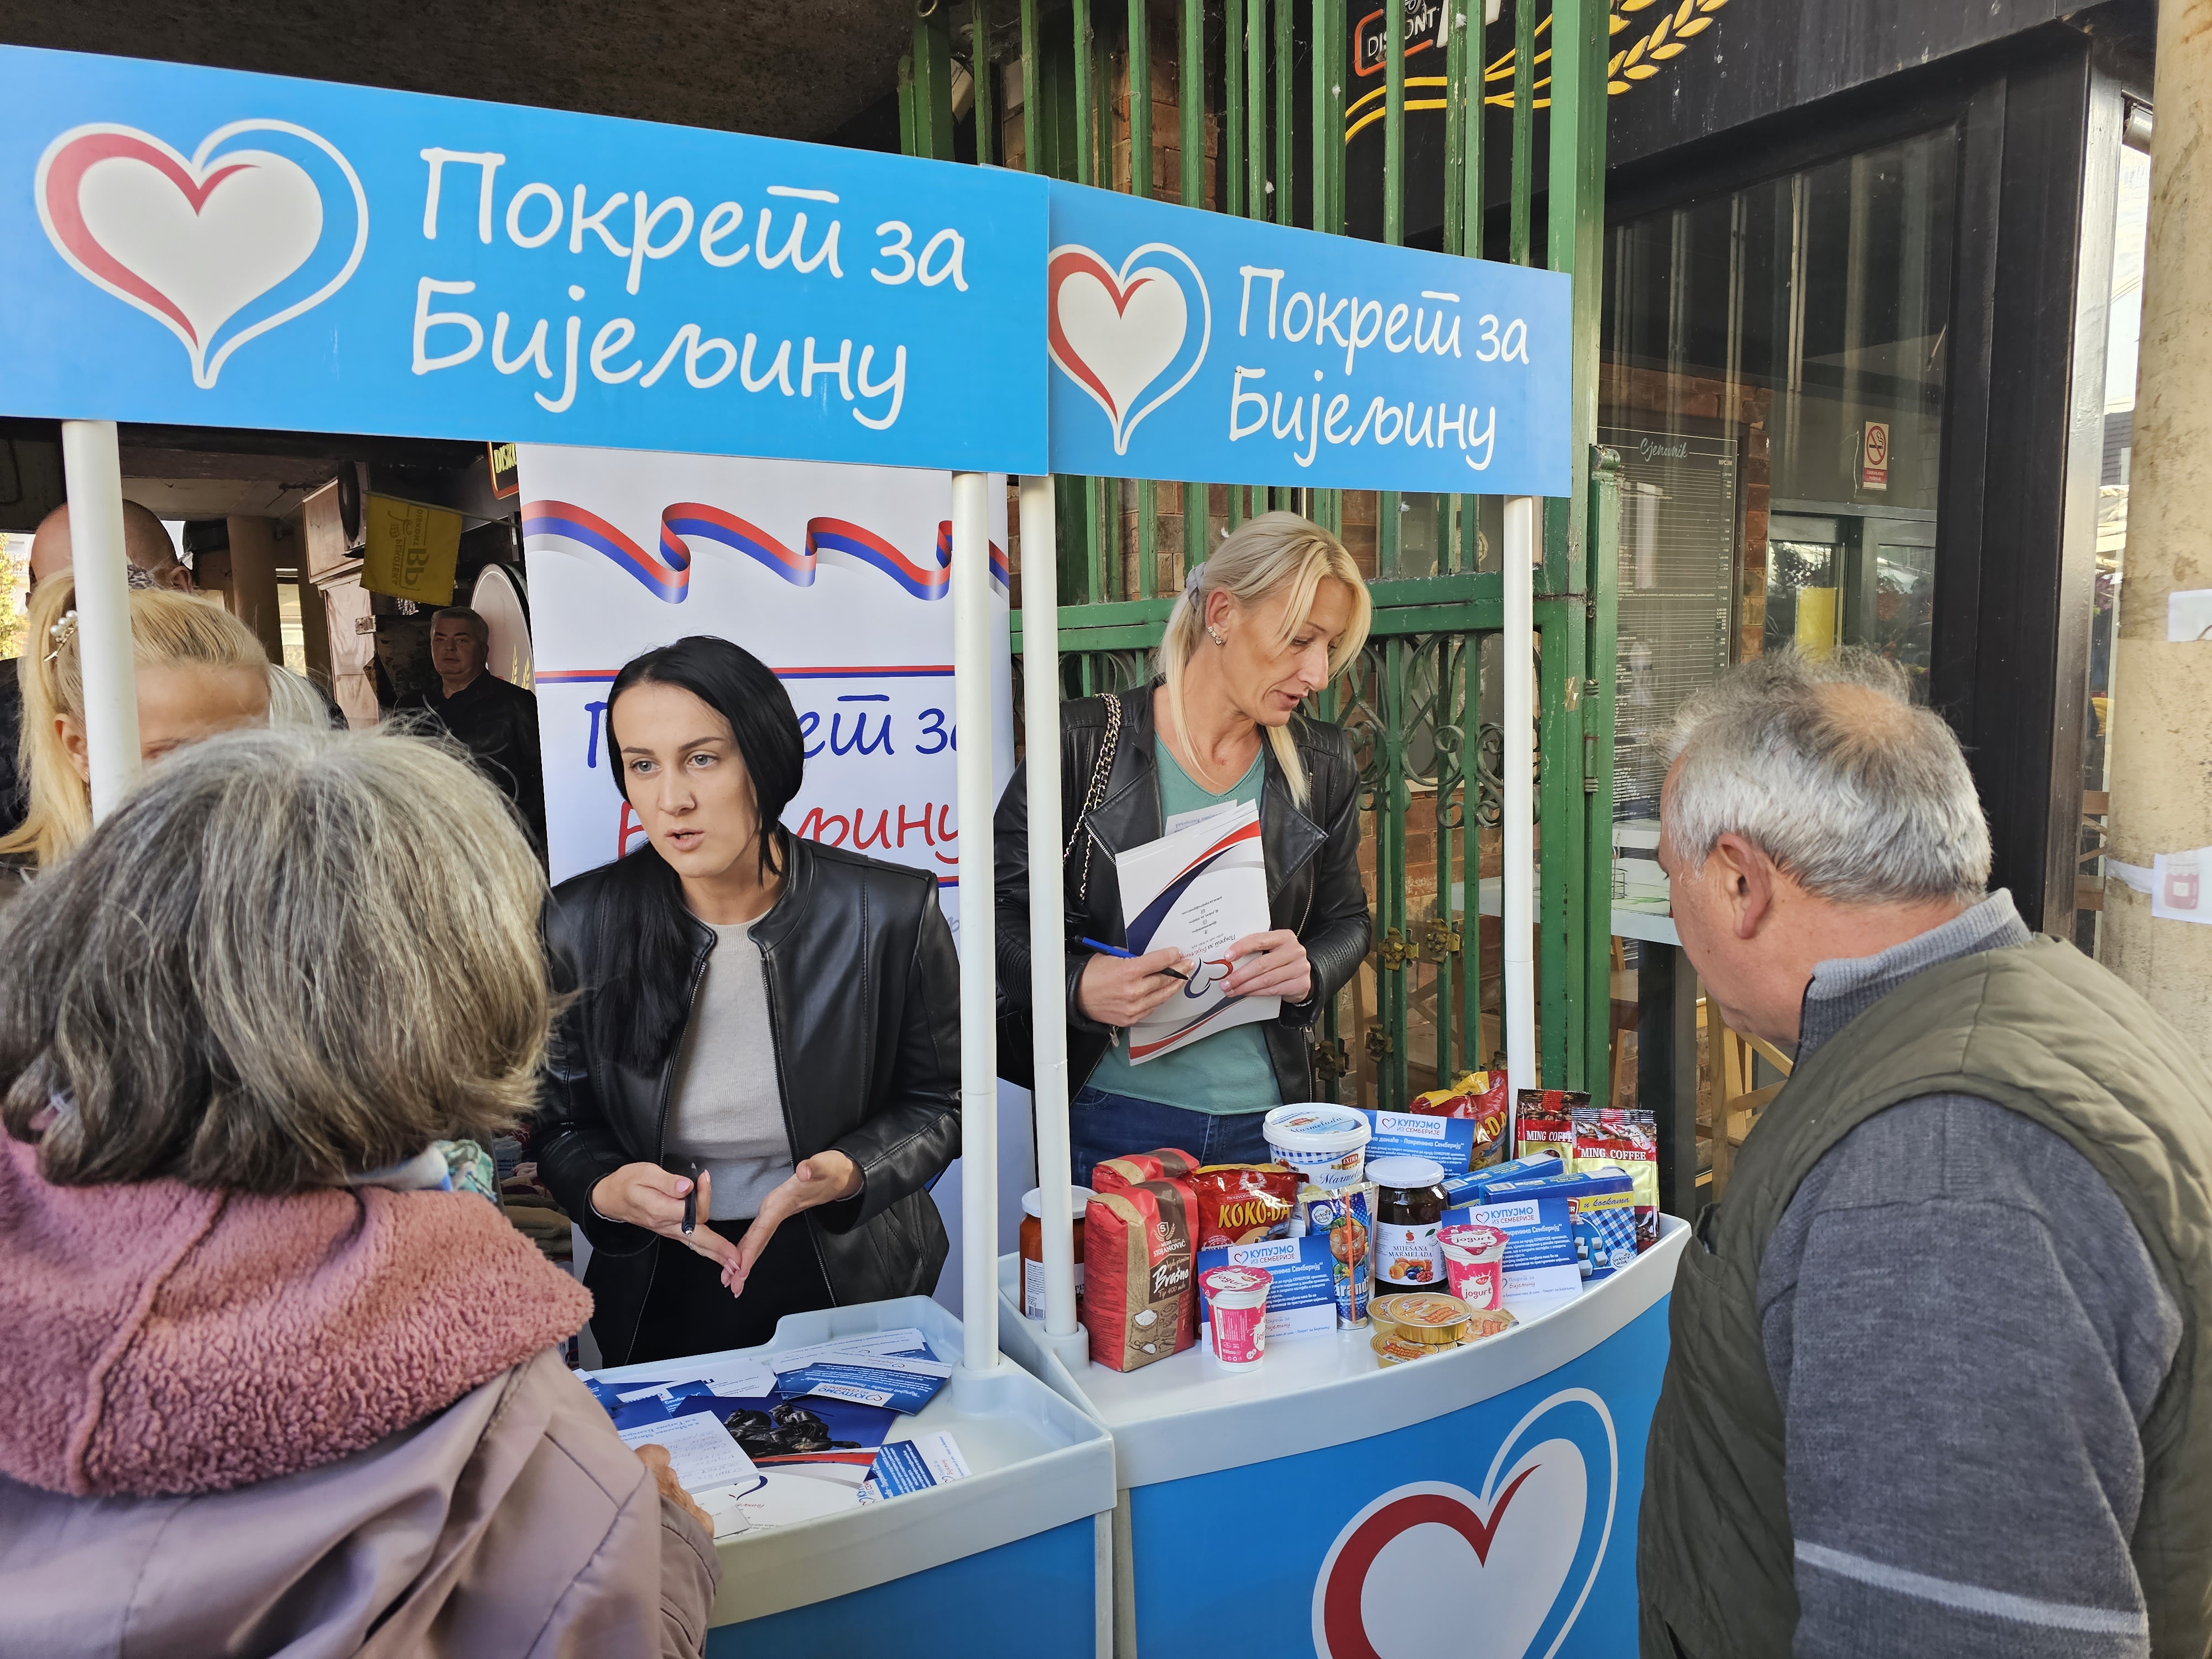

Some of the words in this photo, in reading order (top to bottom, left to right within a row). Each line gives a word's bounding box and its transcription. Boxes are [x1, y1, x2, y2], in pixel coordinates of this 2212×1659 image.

[420, 147, 843, 295] Покрет
[870, 220, 969, 291] за
[1239, 264, 1462, 375] Покрет
[1476, 314, 1530, 365] за
[411, 275, 906, 430] Бијељину
[1229, 366, 1495, 471] Бијељину
[1640, 437, 1688, 462] Cjenovnik
[1214, 934, 1235, 947] Покрет
[1290, 1117, 1343, 1133] Marmelada
[1398, 1119, 1441, 1129] КУПУЈМО
[1404, 1138, 1433, 1147] Покренимо
[1526, 1131, 1546, 1141] MING
[1343, 1154, 1358, 1165] EXTRA
[1580, 1148, 1606, 1158] MING
[1610, 1150, 1646, 1160] COFFEE
[1490, 1207, 1533, 1219] КУПУЈМО
[1500, 1215, 1535, 1224] СЕМБЕРИЈЕ
[1506, 1228, 1531, 1237] окренимо
[1153, 1239, 1186, 1258] STOJANOVIĆ
[1250, 1245, 1294, 1259] КУПУЈМО
[1260, 1254, 1295, 1263] СЕМБЕРИЈЕ
[1152, 1264, 1189, 1294] Brašno
[1210, 1273, 1249, 1287] jogurt
[1158, 1289, 1167, 1300] Tip
[1167, 1286, 1178, 1295] 400
[1464, 1287, 1492, 1299] jogurt
[818, 1387, 867, 1399] КУПУЈМО
